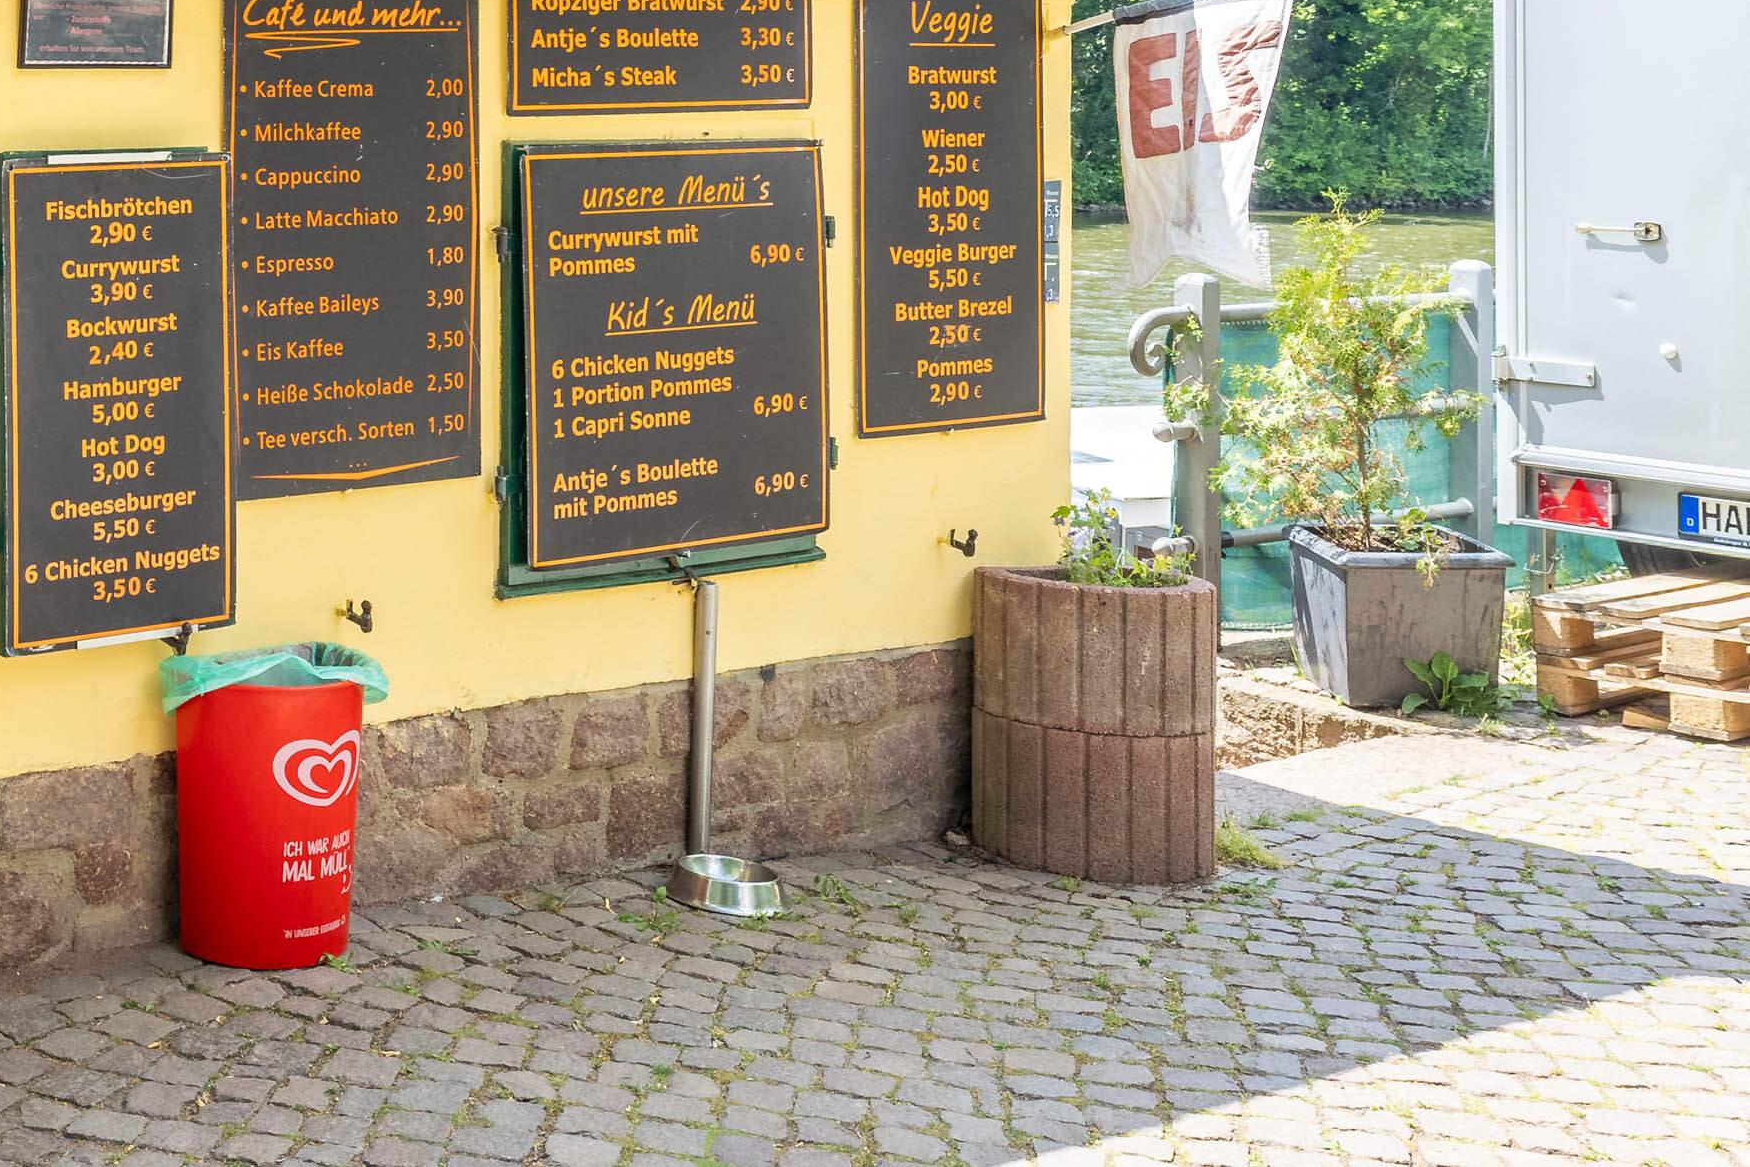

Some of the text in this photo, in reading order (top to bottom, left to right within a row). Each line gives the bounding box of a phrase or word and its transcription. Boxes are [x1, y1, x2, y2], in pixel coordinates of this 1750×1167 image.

[313, 0, 365, 27] und
[911, 0, 993, 43] Veggie
[616, 27, 699, 48] Boulette
[740, 27, 781, 50] 3,30
[621, 65, 677, 86] Steak
[741, 64, 782, 87] 3,50
[908, 65, 997, 84] Bratwurst
[254, 78, 373, 98] Kaffee Crema
[1128, 19, 1282, 159] EIS
[255, 121, 361, 142] Milchkaffee
[921, 128, 986, 148] Wiener
[255, 165, 361, 190] Cappuccino
[46, 196, 192, 221] Fischbrötchen
[582, 186, 665, 210] unsere
[918, 185, 989, 212] Hot Dog
[255, 207, 398, 230] Latte Macchiato
[90, 221, 136, 248] 2,90
[548, 223, 699, 253] Currywurst mit
[61, 254, 180, 281] Currywurst
[256, 255, 334, 277] Espresso
[549, 244, 791, 277] Pommes 6,90
[889, 242, 1017, 268] Veggie Burger
[90, 281, 137, 306] 3,90
[256, 293, 380, 317] Kaffee Baileys
[687, 293, 755, 325] Menü
[895, 295, 1012, 322] Butter Brezel
[66, 313, 178, 339] Bockwurst
[89, 340, 138, 365] 2,40
[257, 338, 344, 361] Eis Kaffee
[551, 346, 735, 380] 6 Chicken Nuggets
[917, 358, 993, 378] Pommes
[63, 376, 182, 401] Hamburger
[257, 375, 414, 406] Heiße Schokolade
[553, 376, 732, 408] 1 Portion Pommes
[92, 400, 139, 426] 5,00
[753, 393, 794, 418] 6,90
[256, 421, 414, 450] Tee versch. Sorten
[554, 409, 691, 439] 1 Capri Sonne
[81, 434, 165, 458] Hot Dog
[92, 459, 139, 485] 3,00
[637, 457, 718, 483] Boulette
[754, 471, 795, 497] 6,90
[50, 490, 196, 521] Cheeseburger
[554, 489, 678, 520] mit Pommes
[93, 517, 139, 544] 5,50
[1702, 502, 1750, 535] HA
[24, 543, 220, 584] 6 Chicken Nuggets
[93, 576, 141, 603] 3,50
[283, 840, 303, 858] ICH
[307, 837, 330, 856] WAR
[282, 859, 315, 883] MAL
